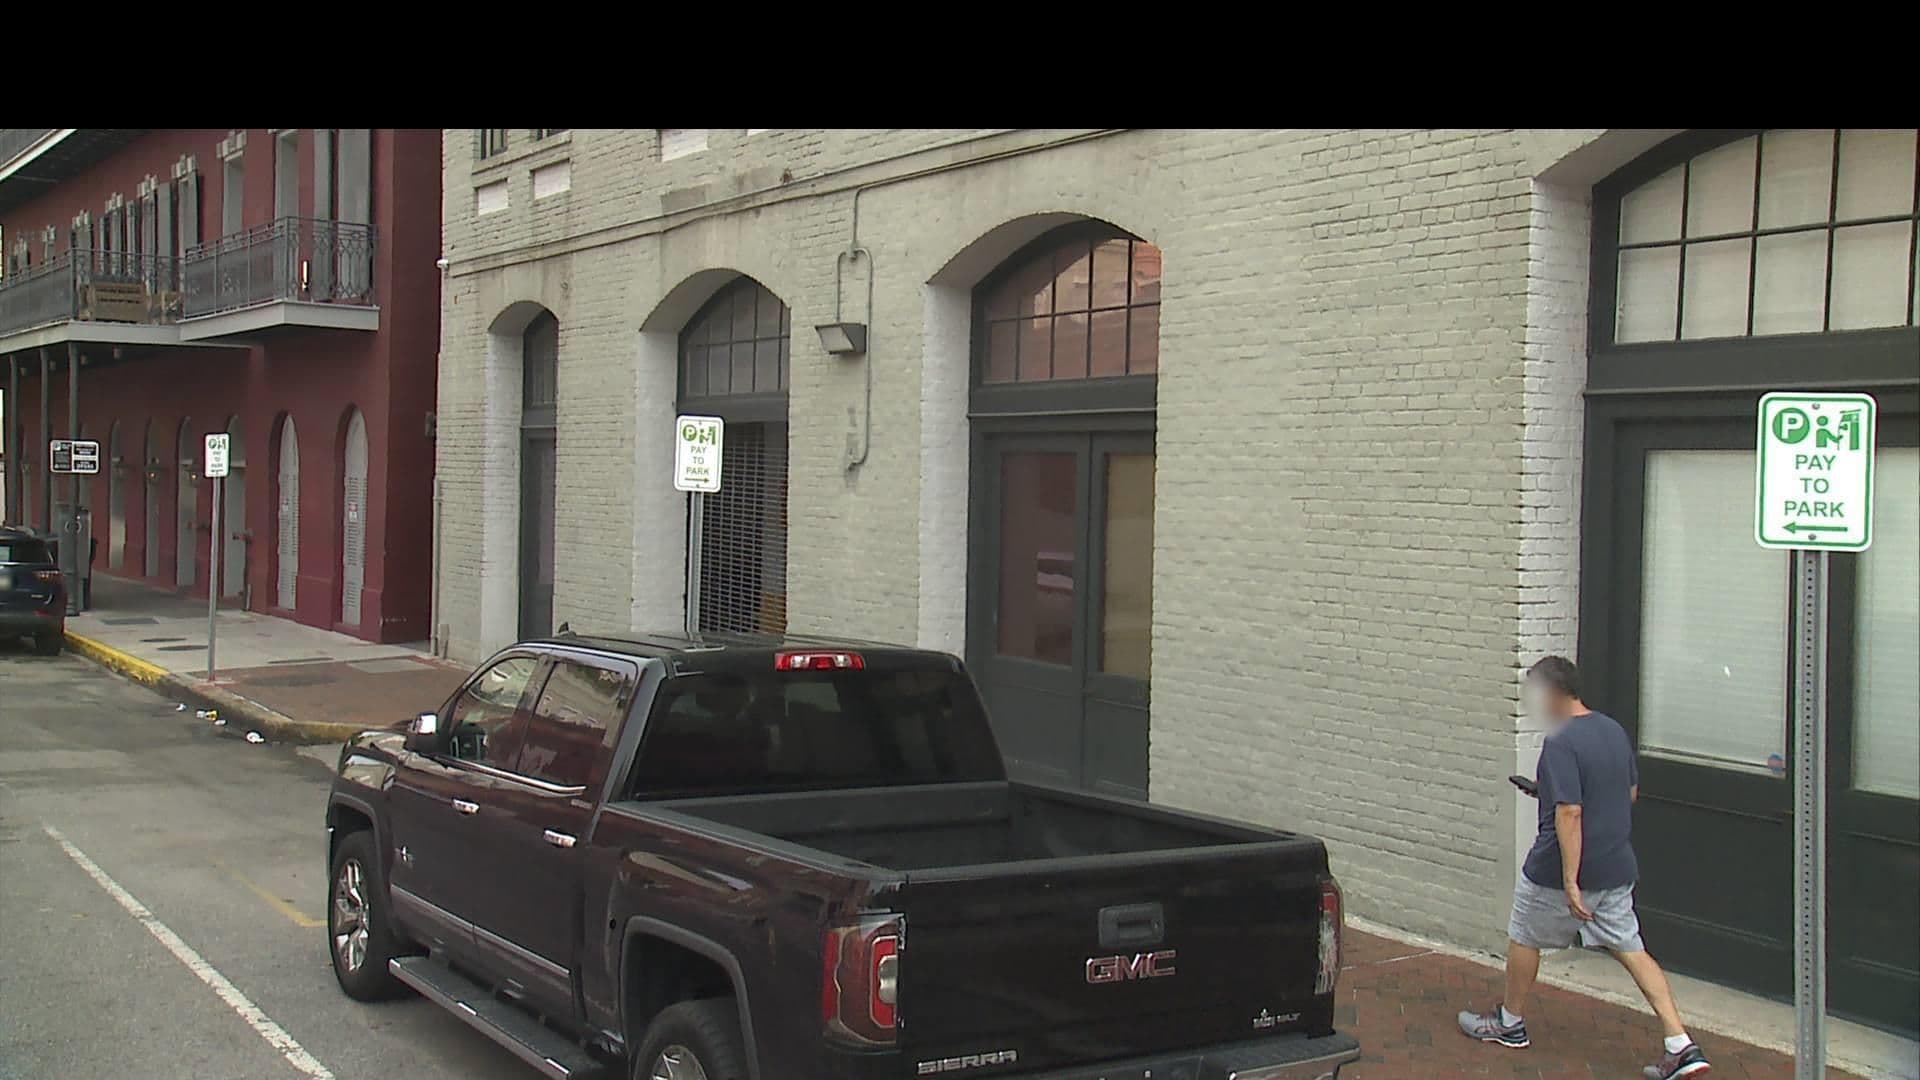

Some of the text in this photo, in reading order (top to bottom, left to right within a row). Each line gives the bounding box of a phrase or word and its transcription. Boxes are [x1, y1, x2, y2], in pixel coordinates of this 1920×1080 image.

[692, 456, 704, 465] TO
[1795, 454, 1836, 471] PAY
[685, 467, 709, 475] PARK
[1800, 477, 1829, 494] TO
[1784, 500, 1844, 518] PARK
[1086, 950, 1176, 983] GMC
[918, 1050, 1017, 1074] SIERRA
